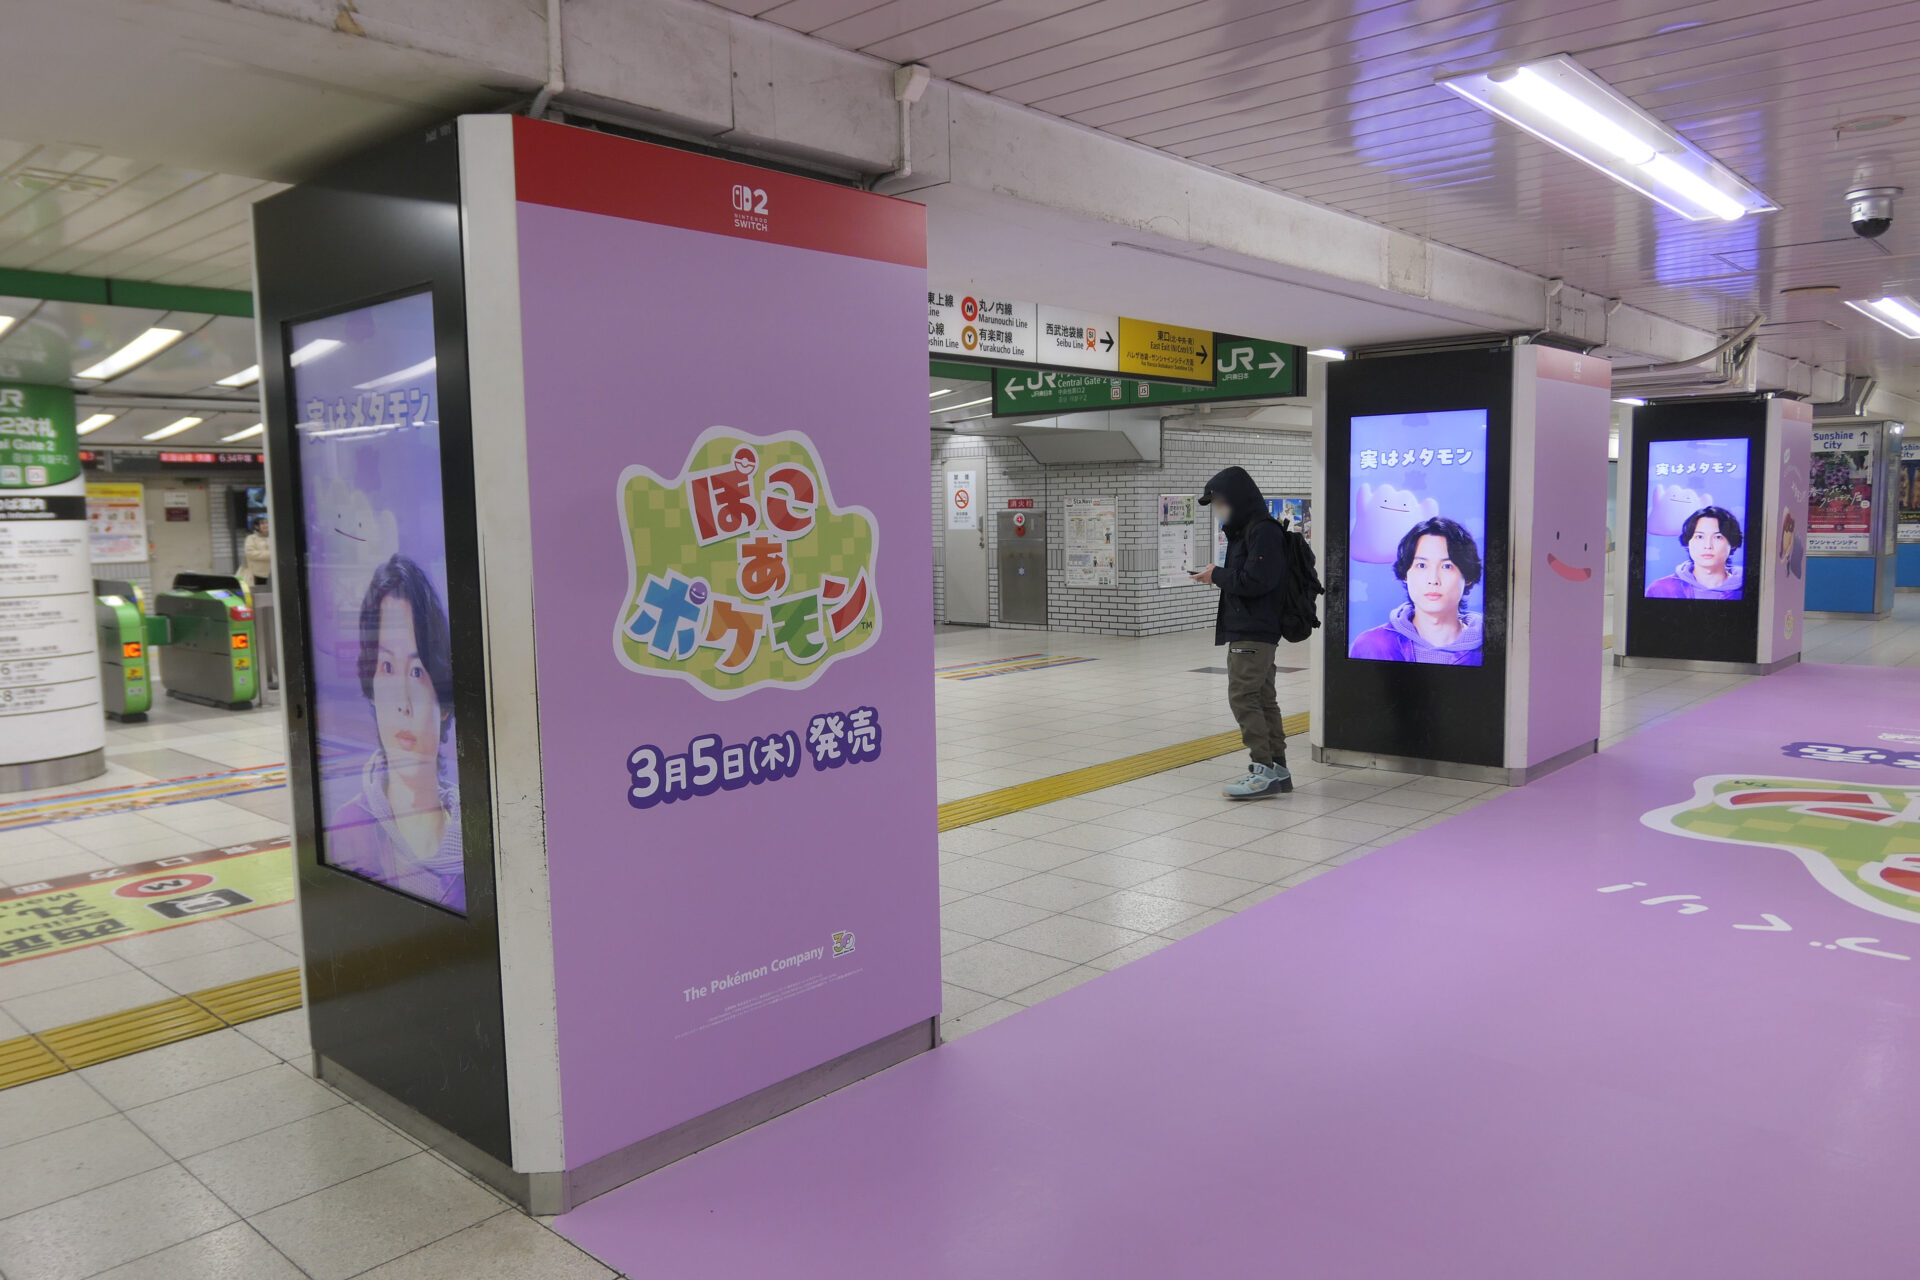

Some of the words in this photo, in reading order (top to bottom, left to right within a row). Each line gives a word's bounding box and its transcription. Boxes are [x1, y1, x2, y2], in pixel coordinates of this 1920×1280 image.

[734, 219, 768, 231] SWITCH
[928, 307, 940, 317] ine
[978, 300, 1013, 315] 丸ノ内線
[978, 313, 1015, 327] Marunouchi
[1015, 318, 1028, 329] Line
[978, 328, 1013, 344] 有楽町線
[1046, 323, 1084, 339] 西武池袋線
[928, 337, 944, 347] shin
[945, 339, 960, 349] Line
[979, 343, 1011, 355] Yurakucho
[1012, 346, 1025, 356] Line
[1056, 338, 1072, 348] Seibu
[1072, 339, 1084, 350] Line
[1150, 341, 1161, 351] East
[1217, 347, 1255, 373] JR
[1027, 371, 1056, 390] JR
[1057, 378, 1083, 388] Central
[1084, 377, 1101, 386] Gate
[1222, 372, 1249, 381] JR東日本
[306, 386, 430, 445] 実はメタモン
[1813, 431, 1854, 441] Sunshine
[46, 441, 54, 451] 2
[1823, 440, 1843, 450] City
[1359, 448, 1474, 469] 実はメタモン
[1655, 462, 1738, 476] 実はメタモン
[1010, 499, 1033, 508] 消火栓
[740, 536, 787, 595] あ
[629, 574, 868, 668] ポケモン
[860, 621, 873, 629] TM
[232, 634, 249, 649] IC
[123, 643, 142, 658] IC
[809, 709, 877, 762] 発売
[3, 911, 110, 936] Seibu
[683, 986, 708, 1002] The
[711, 966, 768, 994] Pokémon
[770, 946, 825, 972] Company
